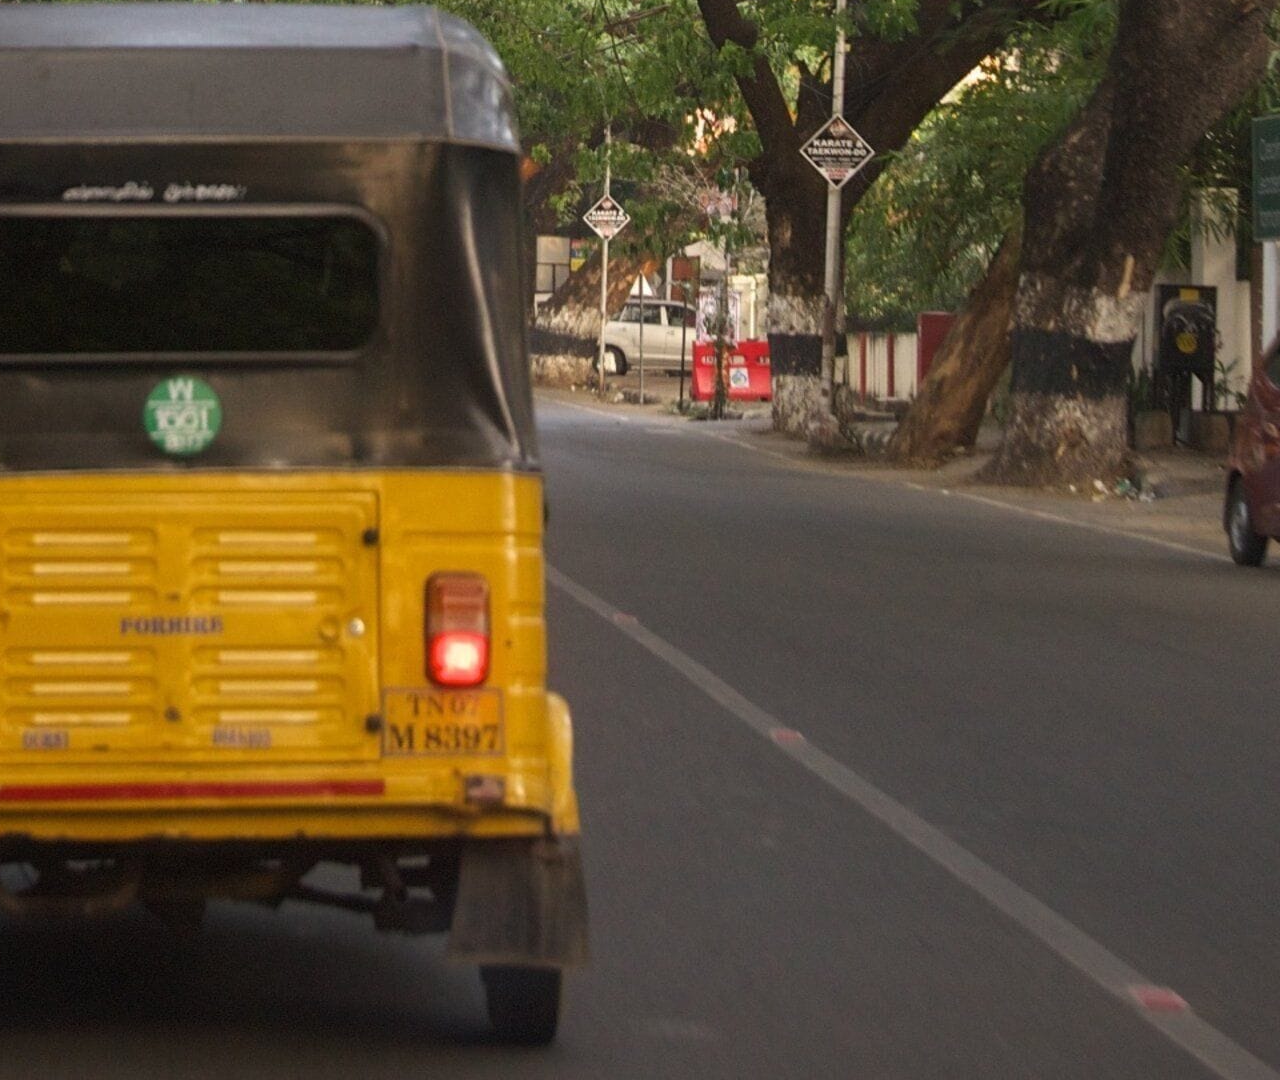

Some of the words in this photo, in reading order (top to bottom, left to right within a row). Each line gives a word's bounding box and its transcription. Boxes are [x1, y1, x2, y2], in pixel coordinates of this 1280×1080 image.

[812, 139, 853, 147] KARATE
[807, 148, 867, 156] TAEKWON-DO
[389, 724, 416, 750] M
[424, 723, 499, 750] 8397
